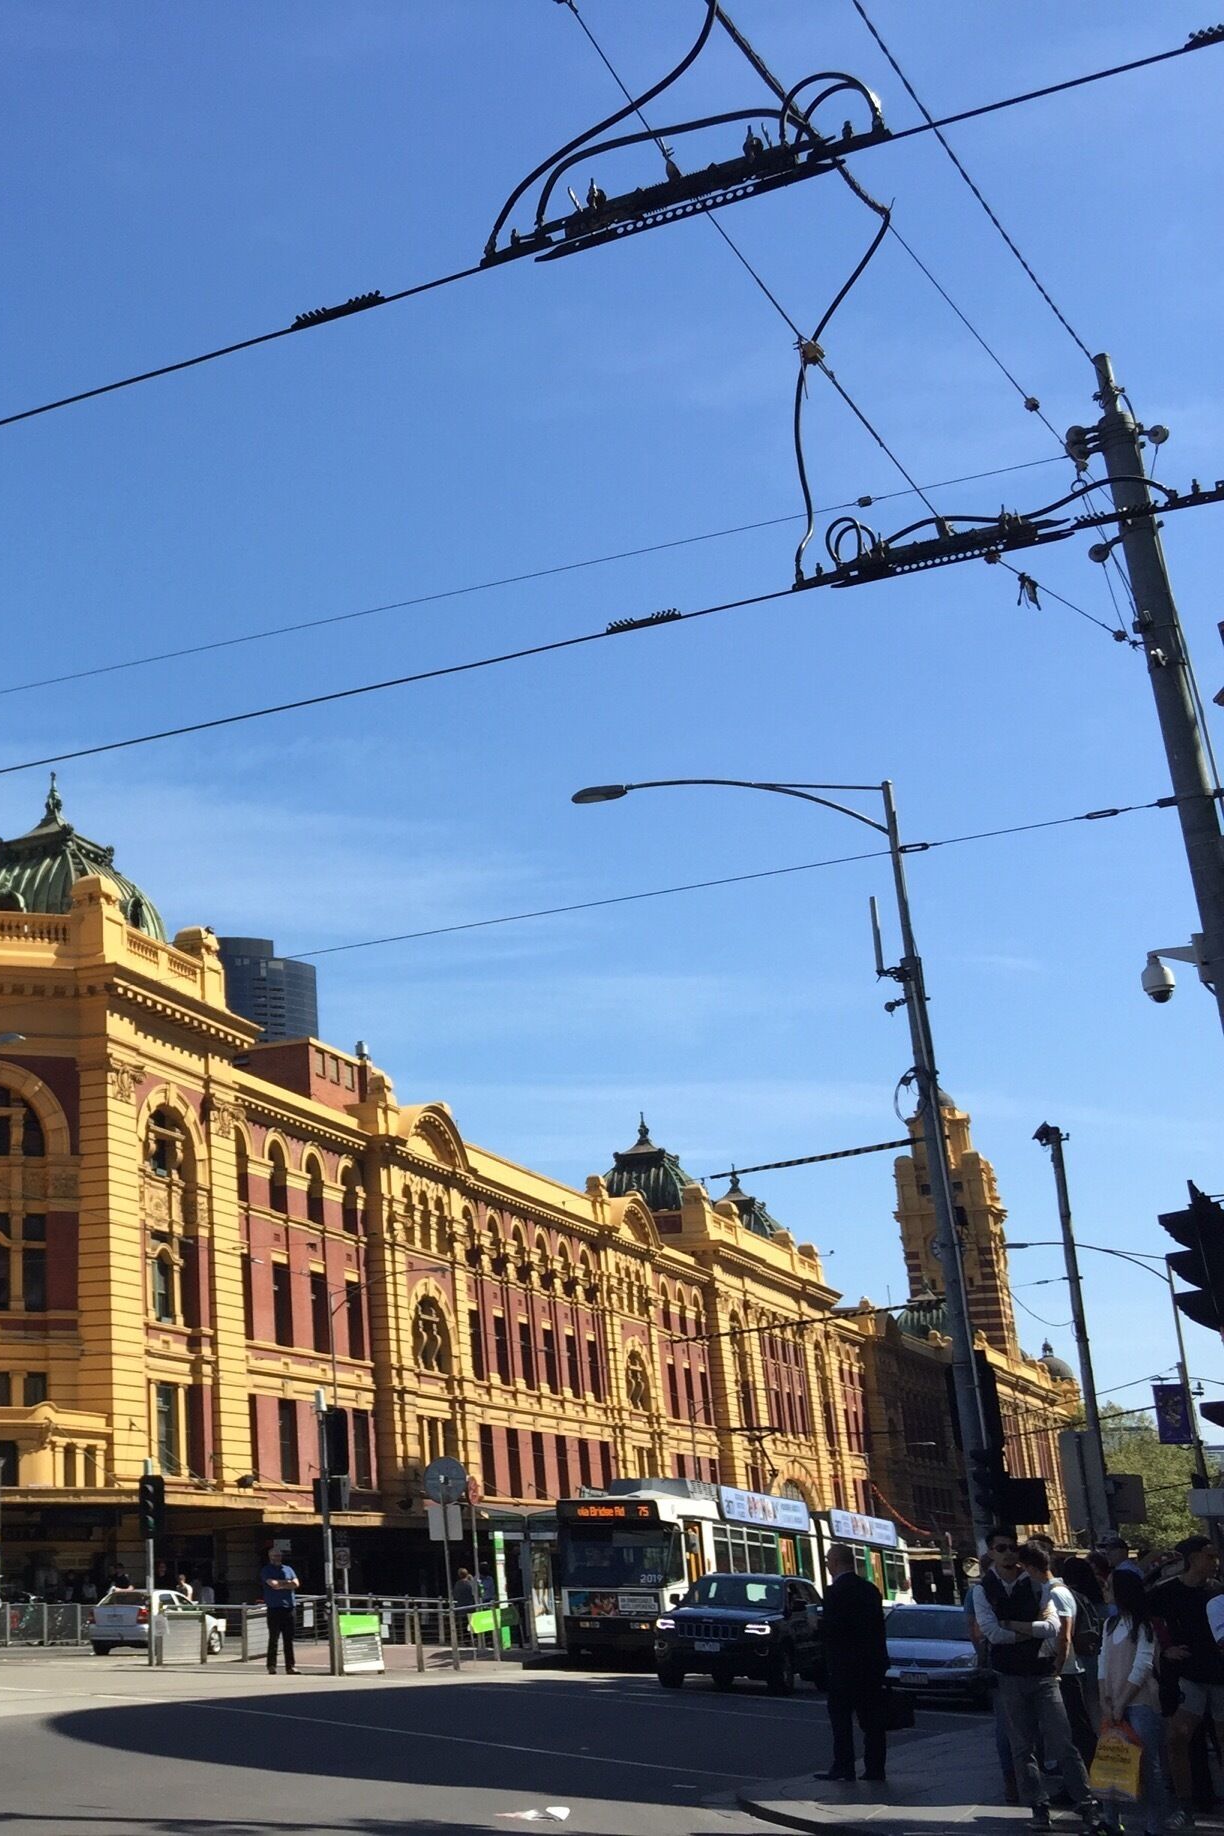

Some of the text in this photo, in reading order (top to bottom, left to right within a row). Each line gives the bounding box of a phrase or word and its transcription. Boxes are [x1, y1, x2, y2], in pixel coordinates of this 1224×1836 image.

[577, 1506, 589, 1517] via
[614, 1506, 625, 1517] Rd
[637, 1506, 649, 1517] 75
[640, 1573, 663, 1583] 2019
